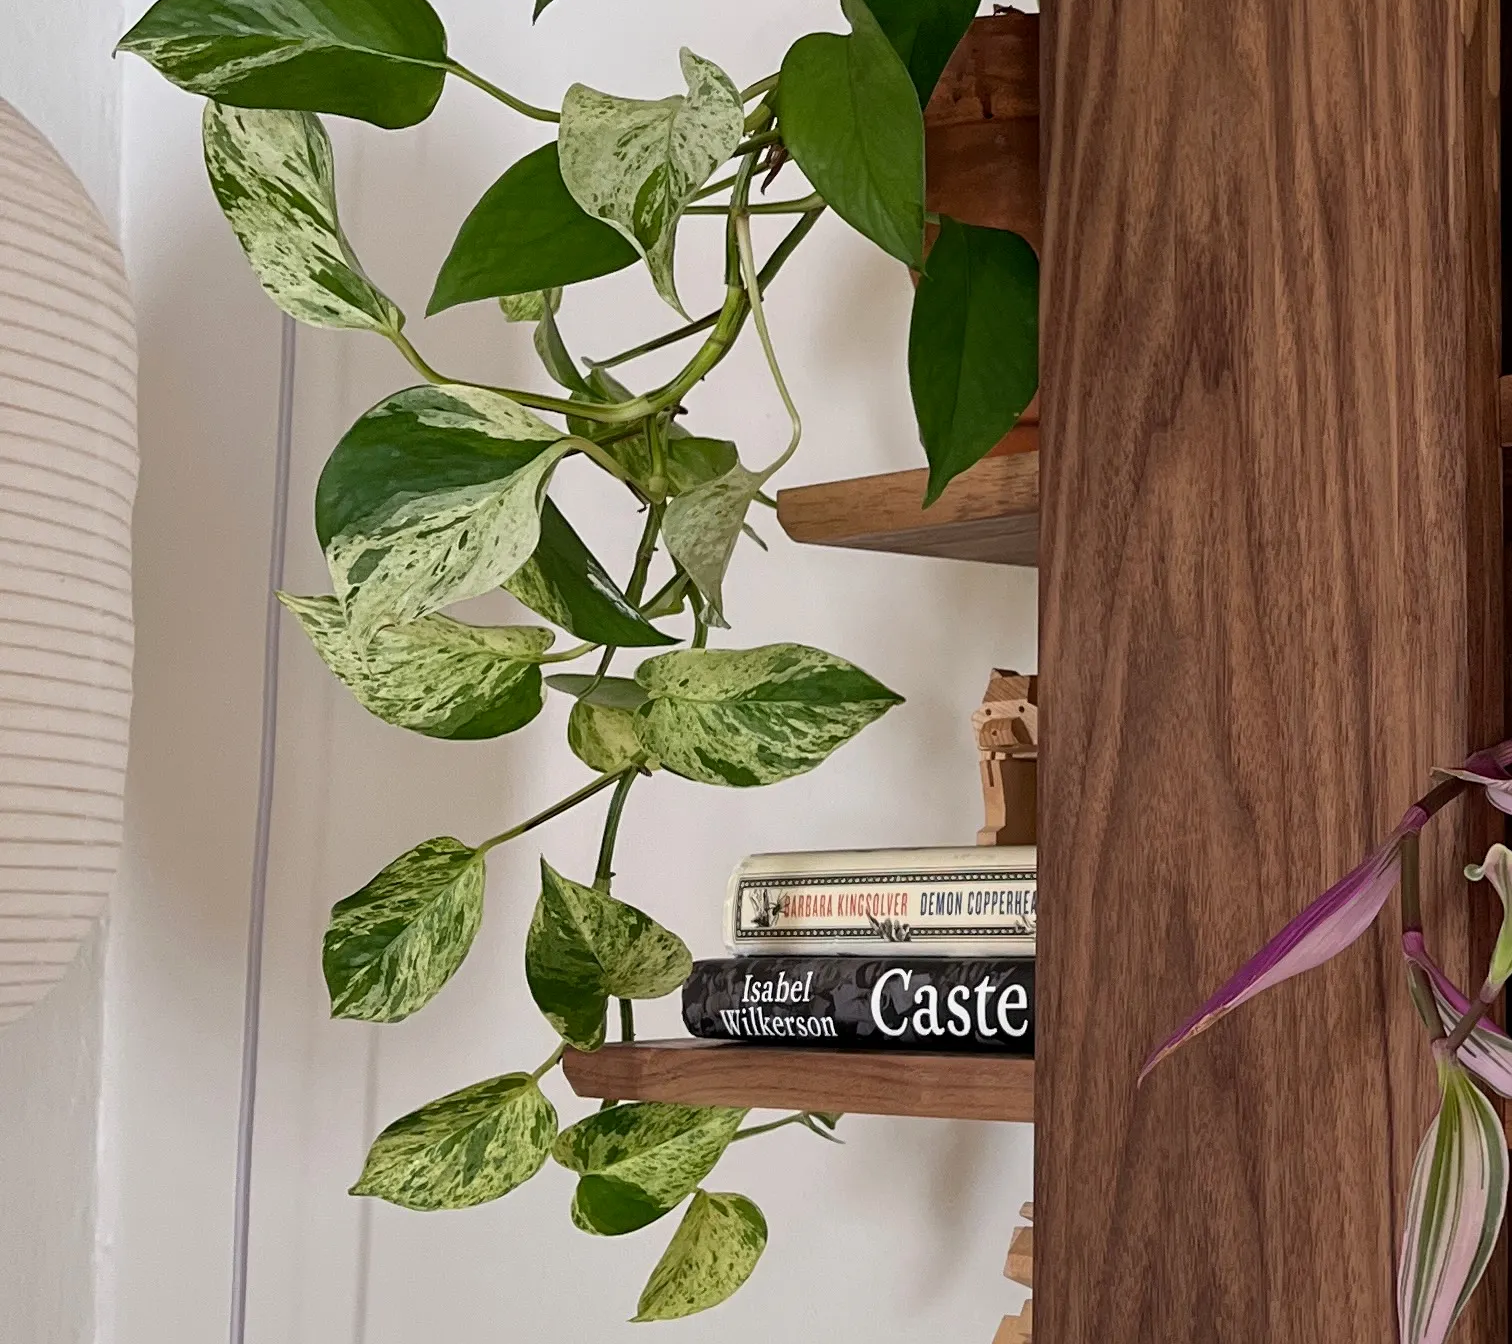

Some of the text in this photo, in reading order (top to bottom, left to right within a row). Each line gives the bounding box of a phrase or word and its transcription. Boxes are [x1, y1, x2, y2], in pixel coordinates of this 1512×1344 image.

[783, 892, 908, 918] BARBARA KINGSOLVER
[919, 889, 1037, 916] DEMON COPPERHEA
[742, 971, 814, 1004] Isabel
[871, 968, 1029, 1037] Caste
[720, 1009, 838, 1037] Wilkerson
